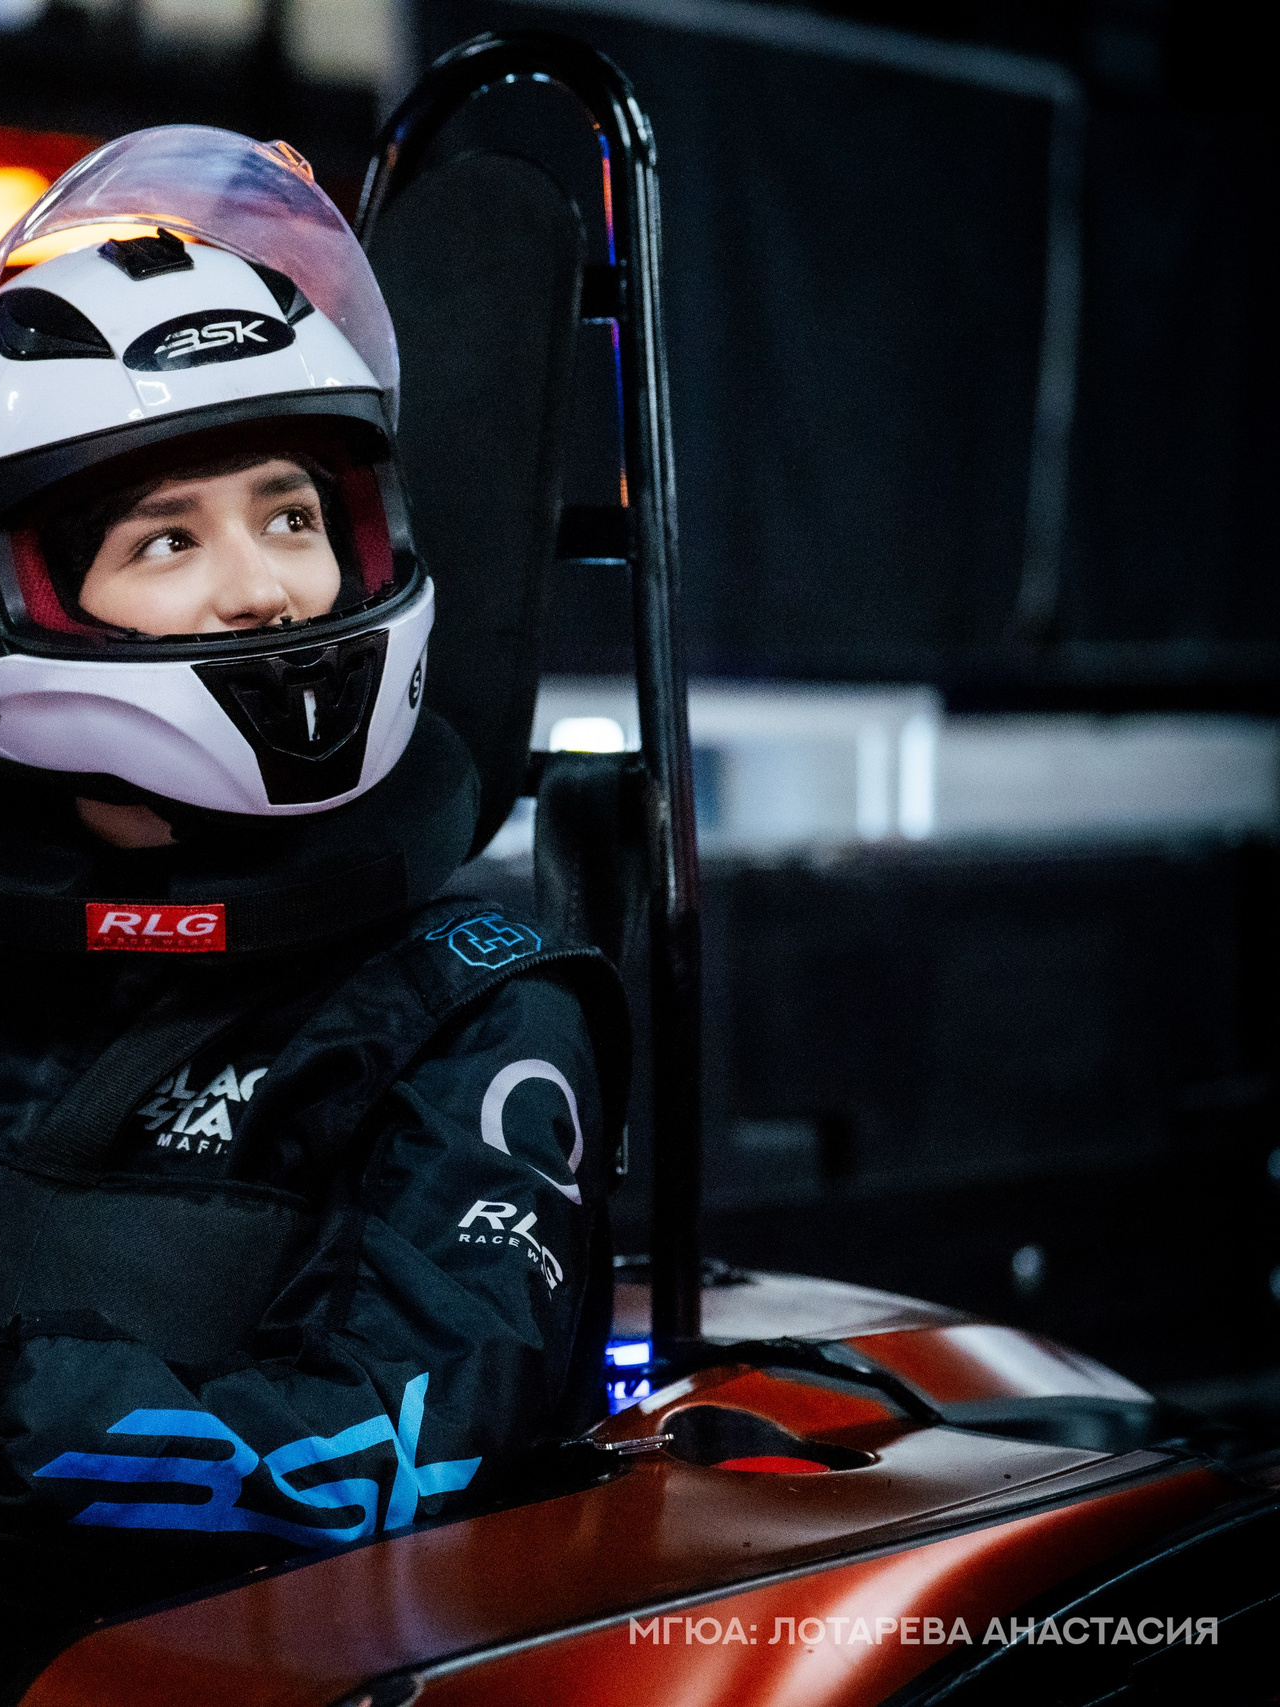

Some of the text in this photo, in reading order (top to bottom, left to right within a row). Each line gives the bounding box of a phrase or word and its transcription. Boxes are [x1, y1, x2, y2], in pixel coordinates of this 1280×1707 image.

[98, 911, 219, 937] RLG
[137, 1096, 233, 1141] STA
[156, 1133, 228, 1154] MAFI
[458, 1200, 563, 1290] RLG
[459, 1234, 520, 1248] RACE
